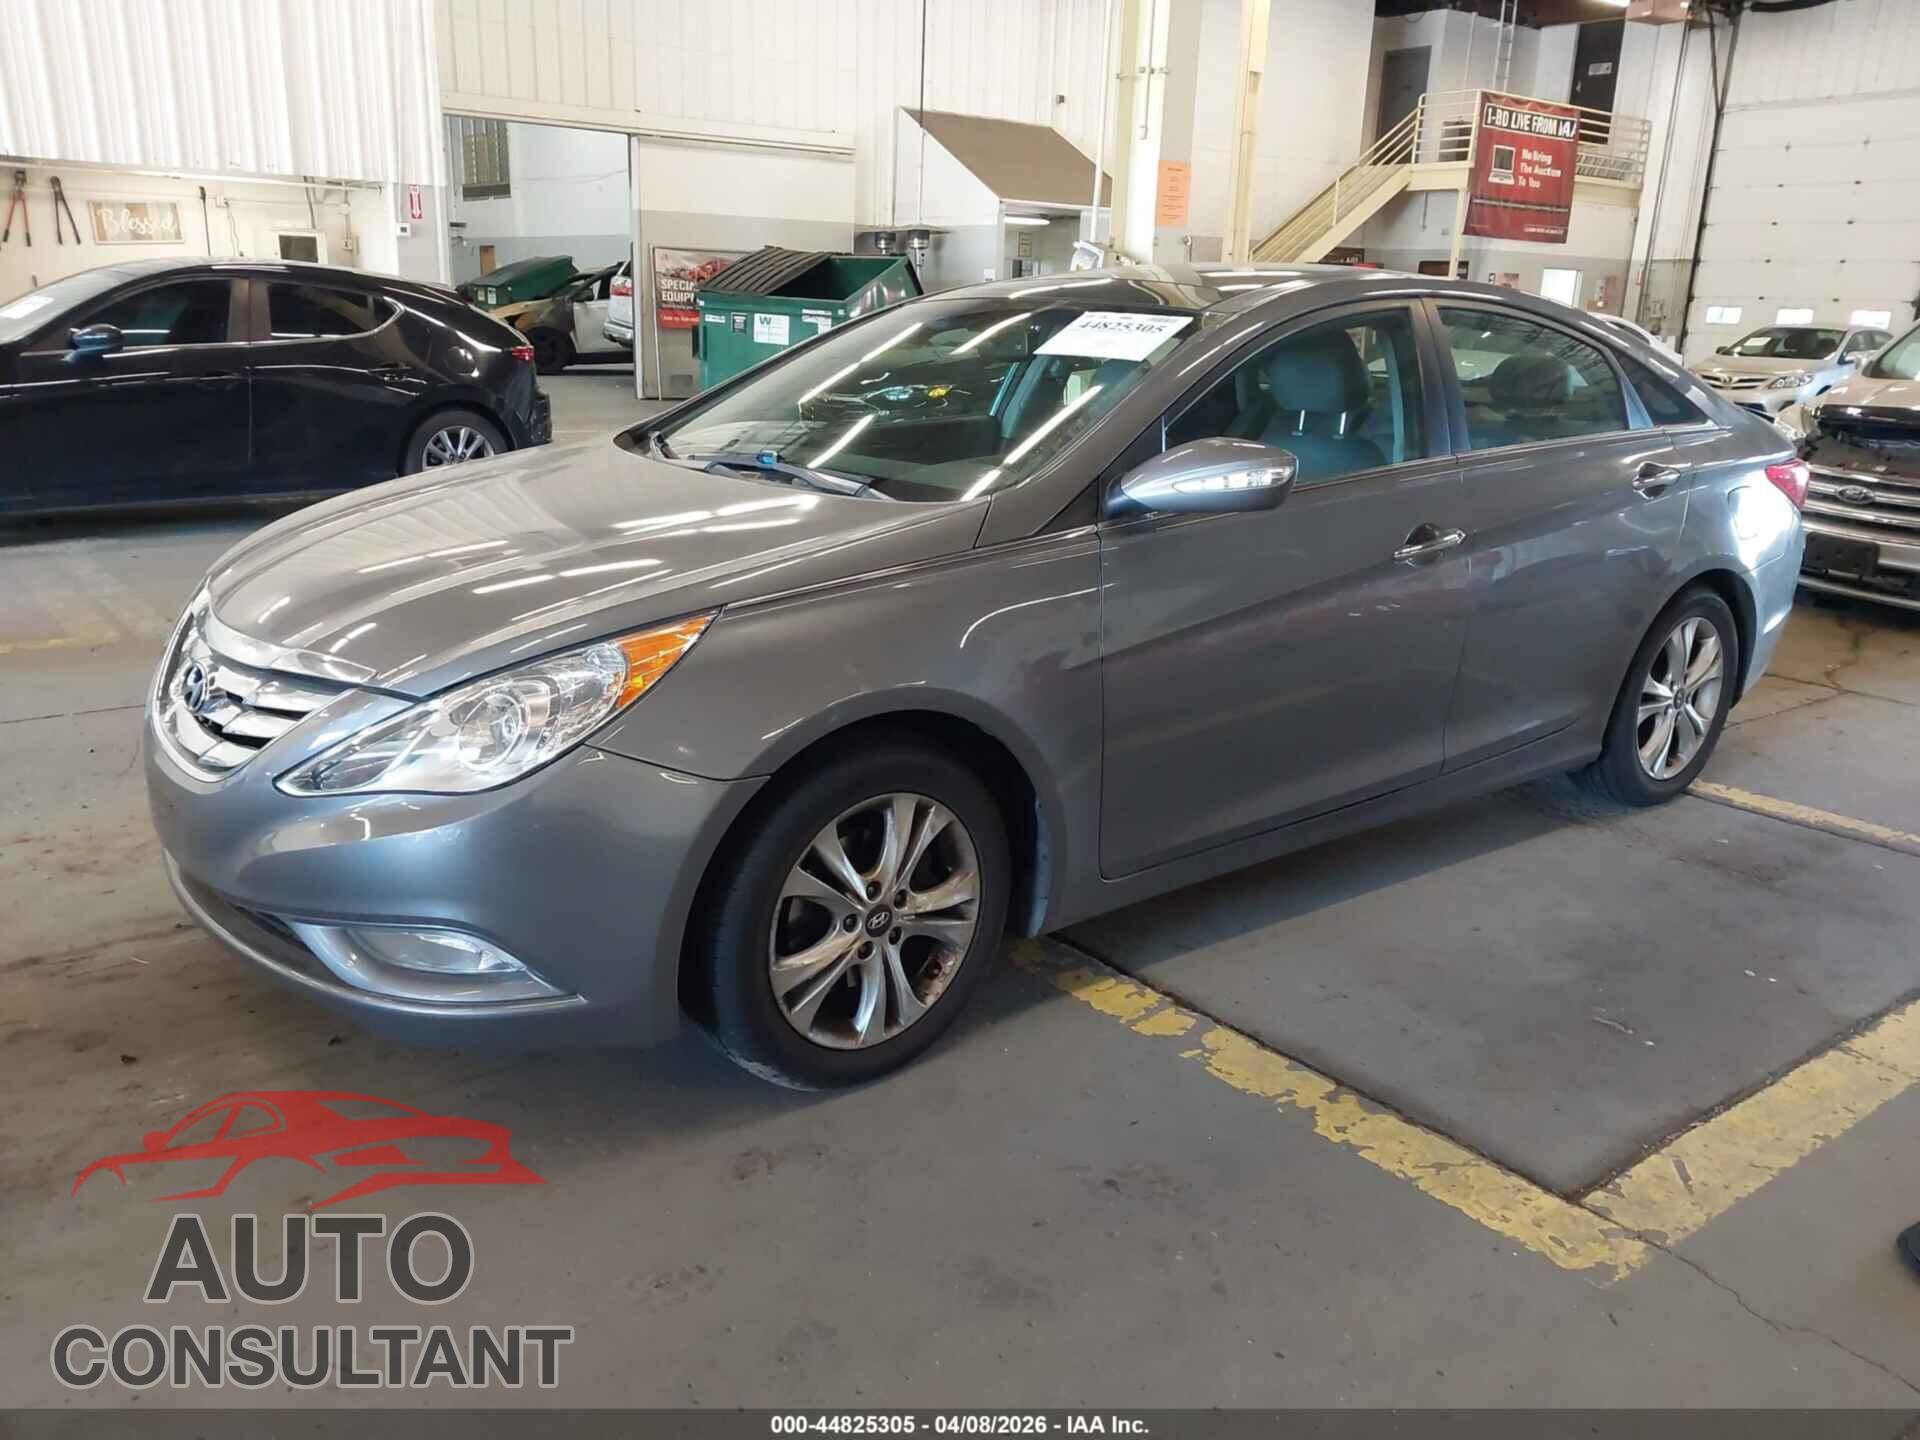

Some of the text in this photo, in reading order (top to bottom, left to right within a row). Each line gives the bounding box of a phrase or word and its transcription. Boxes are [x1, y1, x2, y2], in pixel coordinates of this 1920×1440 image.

[1511, 112, 1531, 131] LIVE
[1531, 115, 1557, 135] FROM
[1520, 162, 1532, 173] The
[1079, 320, 1167, 333] 44825305
